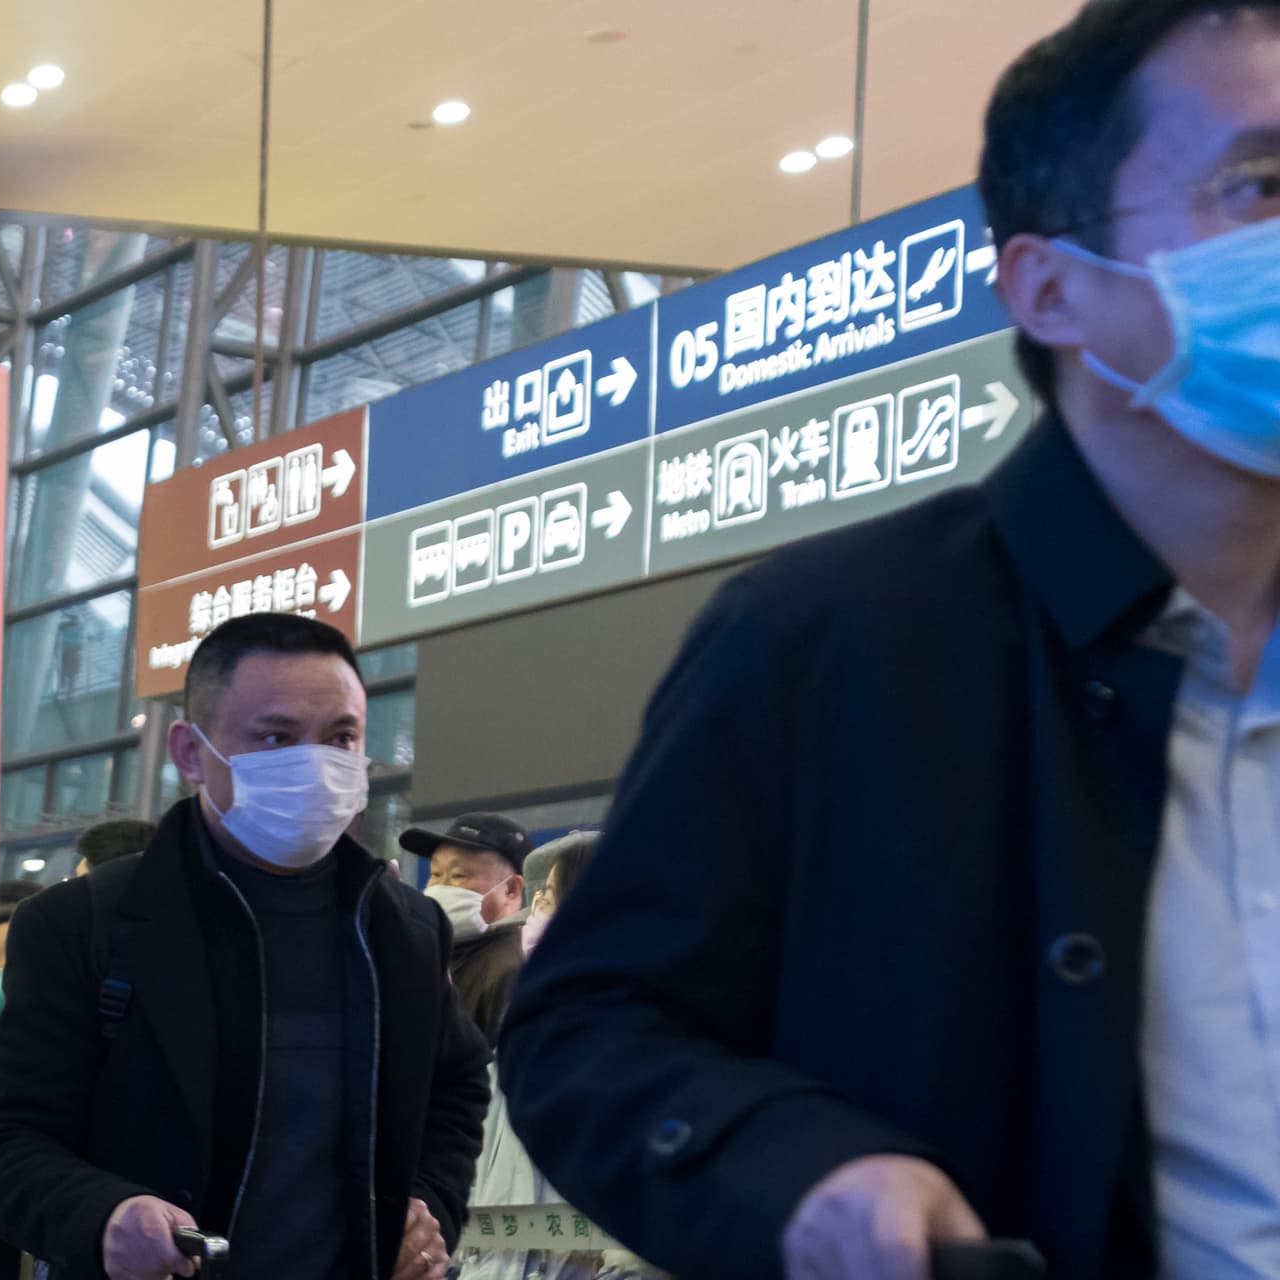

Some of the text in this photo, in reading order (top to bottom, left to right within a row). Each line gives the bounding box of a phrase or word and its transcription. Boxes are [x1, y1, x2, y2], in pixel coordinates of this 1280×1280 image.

[669, 239, 897, 389] 05 国内到达
[718, 312, 896, 396] Domestic Arrivals
[481, 369, 542, 432] 出口
[501, 421, 540, 459] Exit
[769, 417, 831, 478] 火车
[656, 448, 713, 505] 地铁
[778, 472, 827, 512] Train
[660, 509, 711, 544] Metro
[188, 562, 318, 634] 综合服务柜台
[462, 1211, 612, 1238] 国梦·农商
